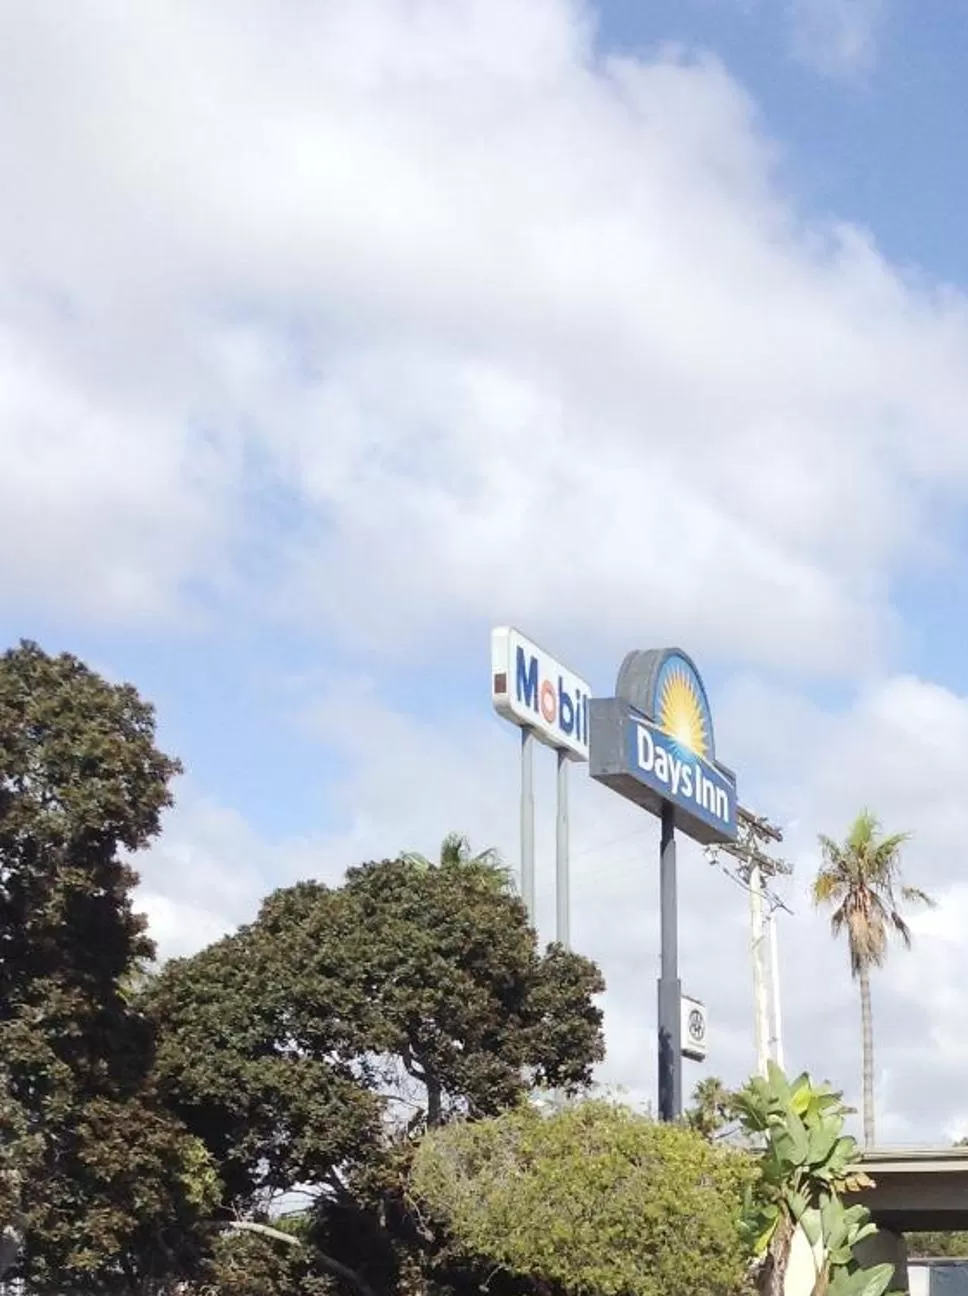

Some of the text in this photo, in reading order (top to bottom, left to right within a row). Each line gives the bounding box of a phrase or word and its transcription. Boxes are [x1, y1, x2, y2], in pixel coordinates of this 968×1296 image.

[516, 645, 588, 747] Mobil
[637, 724, 729, 823] Days Inn
